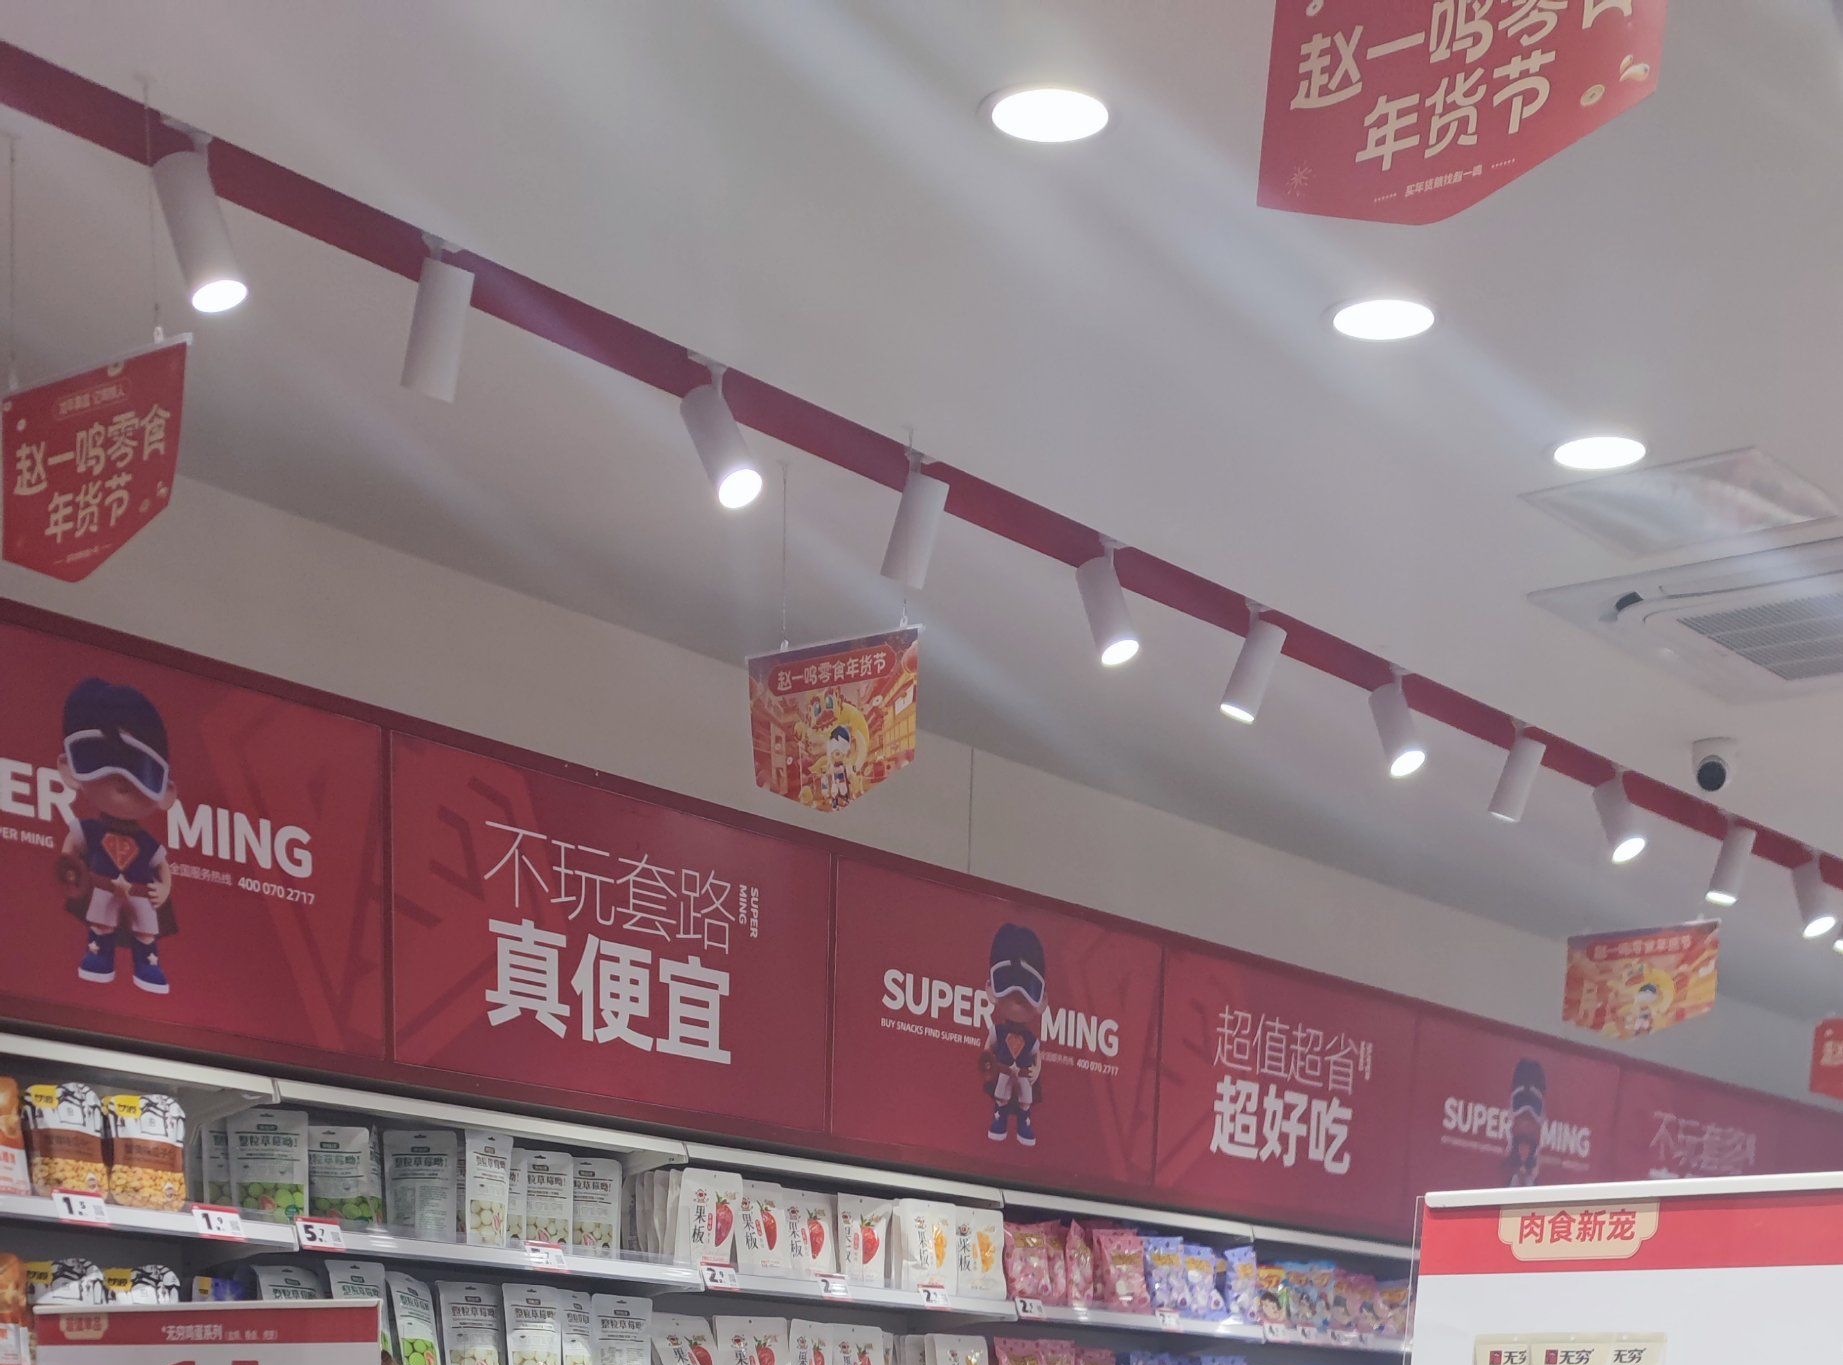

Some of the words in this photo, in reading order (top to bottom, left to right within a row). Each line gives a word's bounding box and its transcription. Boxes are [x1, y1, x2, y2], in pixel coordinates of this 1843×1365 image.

[1356, 50, 1556, 171] 年货节
[13, 404, 170, 495] 赵一鸣零食
[45, 472, 133, 543] 年货节
[777, 651, 887, 691] 赵一鸣零食年货节
[167, 800, 313, 878] MING
[238, 876, 261, 892] 400
[262, 881, 285, 899] 070
[286, 887, 315, 905] 2717
[483, 820, 735, 954] 不玩套路
[738, 883, 748, 926] MING
[749, 886, 759, 939] SUPER
[485, 918, 731, 1064] 真便宜
[882, 968, 995, 1030] SUPER
[1040, 1004, 1119, 1057] MING
[881, 1017, 895, 1028] BUY
[897, 1020, 924, 1035] SNACKS
[924, 1026, 940, 1039] FIND
[941, 1029, 963, 1044] SUPER
[963, 1034, 981, 1047] MING
[1213, 1005, 1358, 1095] 超值超省
[1210, 1075, 1352, 1174] 超好吃
[1442, 1096, 1512, 1139] SUPER
[1540, 1118, 1591, 1158] MING
[692, 1205, 706, 1244] 果板
[742, 1213, 759, 1250] 果板
[1518, 1209, 1637, 1244] 肉食新宠
[1559, 1349, 1594, 1365] 无穷
[1614, 1348, 1646, 1364] 无穷
